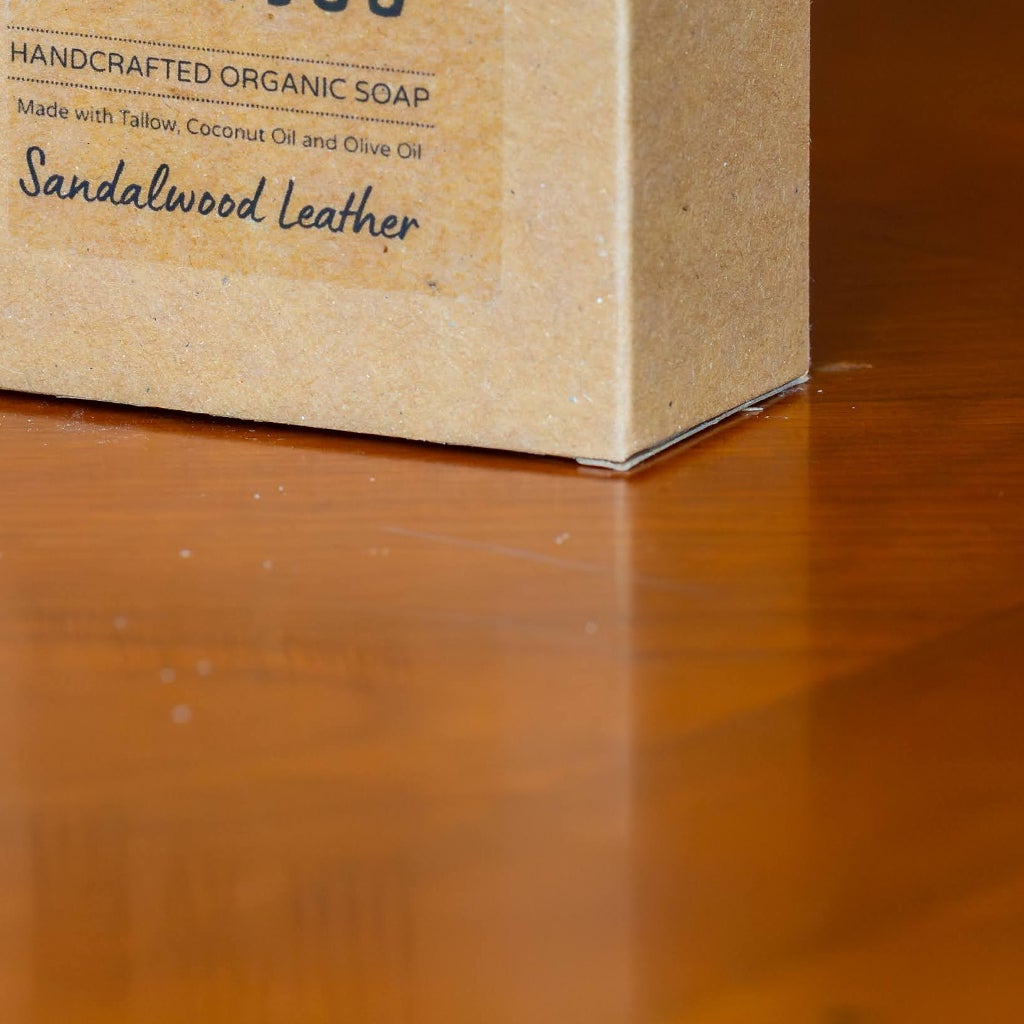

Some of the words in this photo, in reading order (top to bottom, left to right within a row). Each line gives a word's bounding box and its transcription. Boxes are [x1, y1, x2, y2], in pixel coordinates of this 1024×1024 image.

[10, 41, 212, 84] HANDCRAFTED
[220, 65, 347, 101] ORGANIC
[354, 80, 430, 108] SOAP
[17, 97, 69, 119] Made
[74, 107, 114, 125] with
[119, 109, 181, 135] Tallow,
[186, 118, 266, 143] Coconut
[271, 127, 296, 146] Oil
[302, 134, 337, 151] and
[343, 136, 391, 157] Olive
[397, 142, 422, 160] Oil
[19, 145, 266, 223] Sandalwood
[278, 178, 420, 241] Leather
